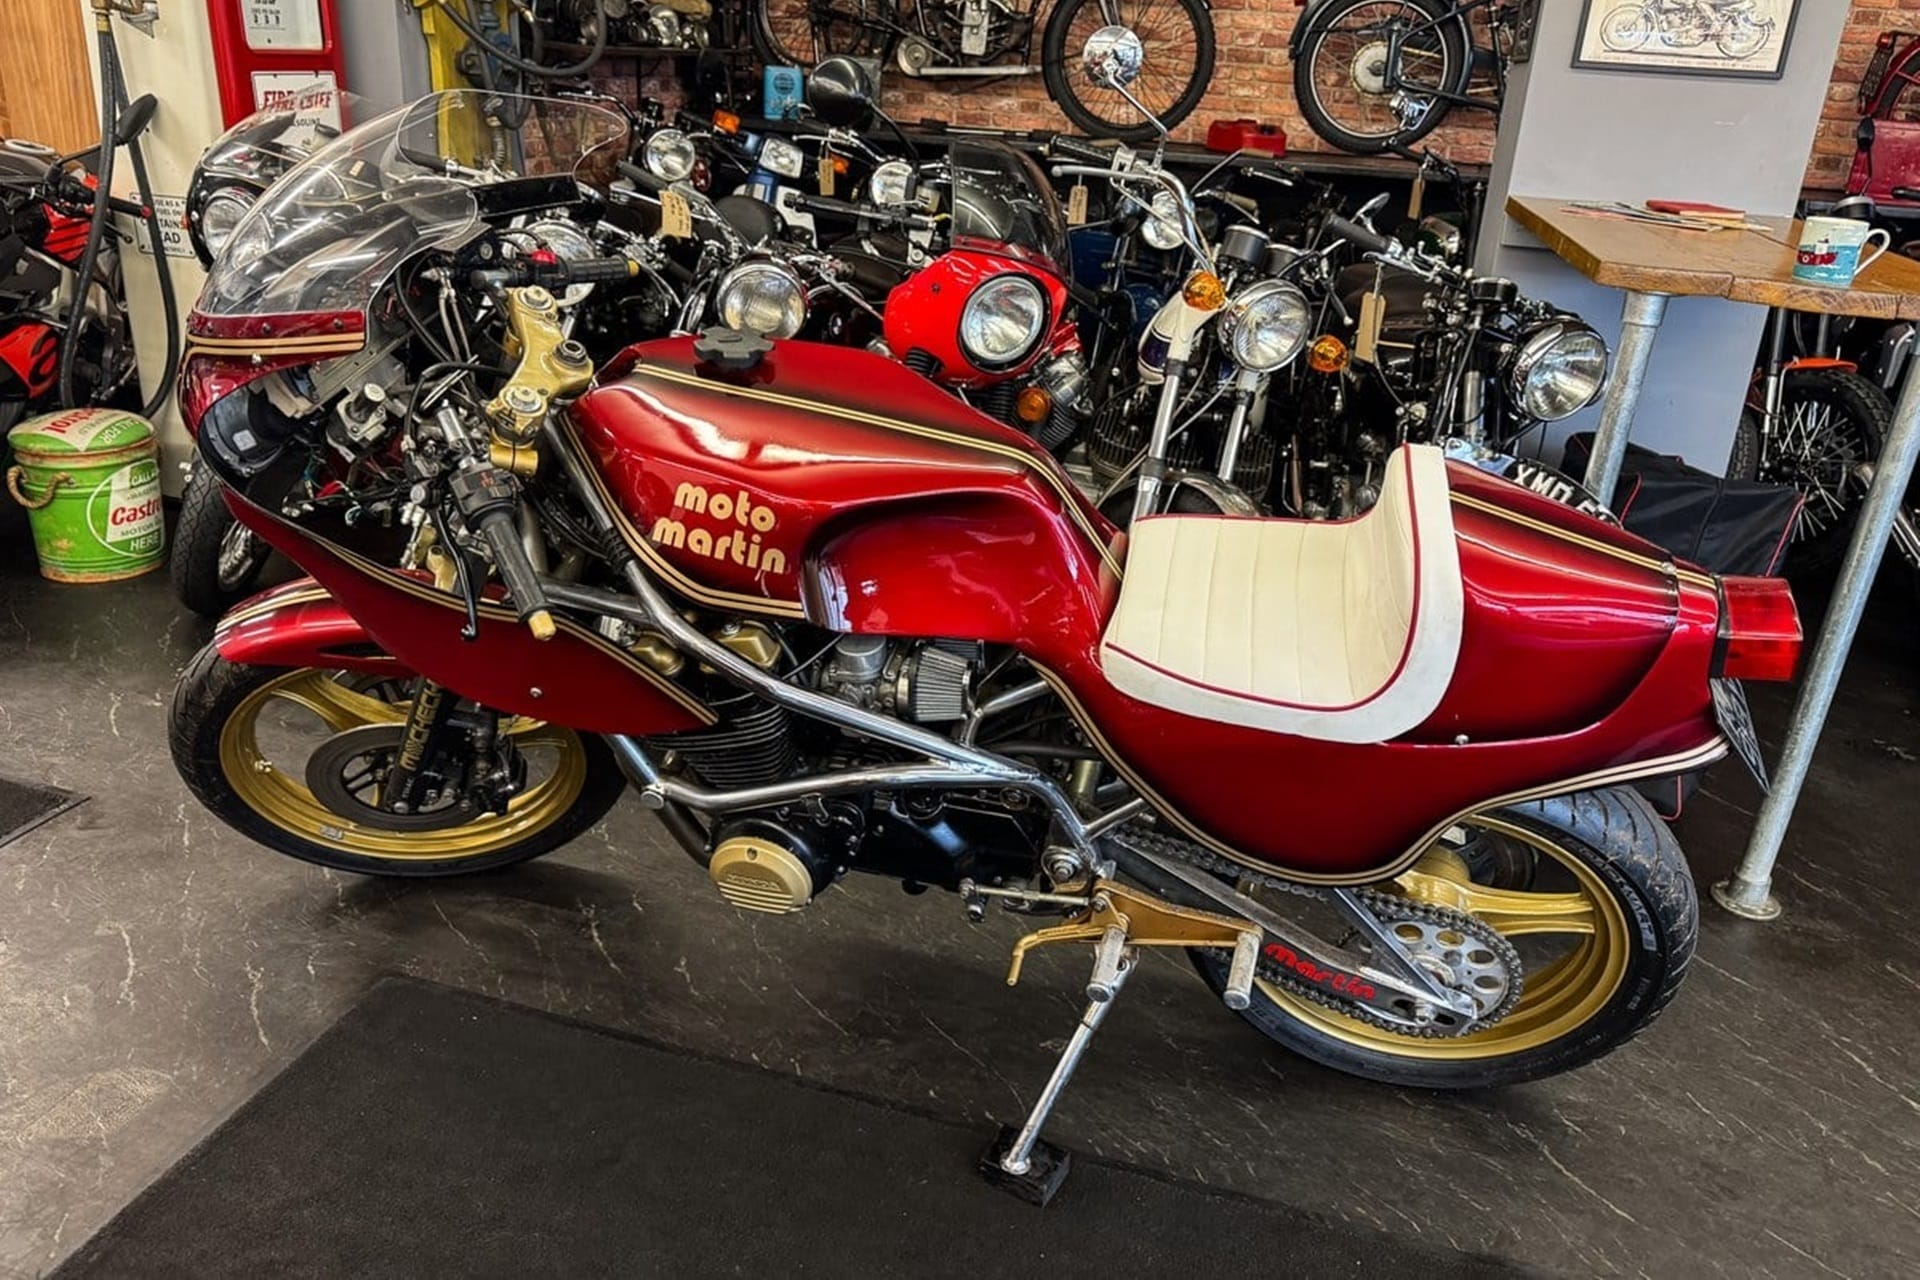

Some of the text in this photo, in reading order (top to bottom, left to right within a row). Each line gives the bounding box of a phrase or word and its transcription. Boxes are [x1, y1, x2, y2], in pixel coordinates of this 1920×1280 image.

[674, 482, 775, 532] moto
[652, 517, 785, 574] martin
[1264, 943, 1376, 1000] martin
